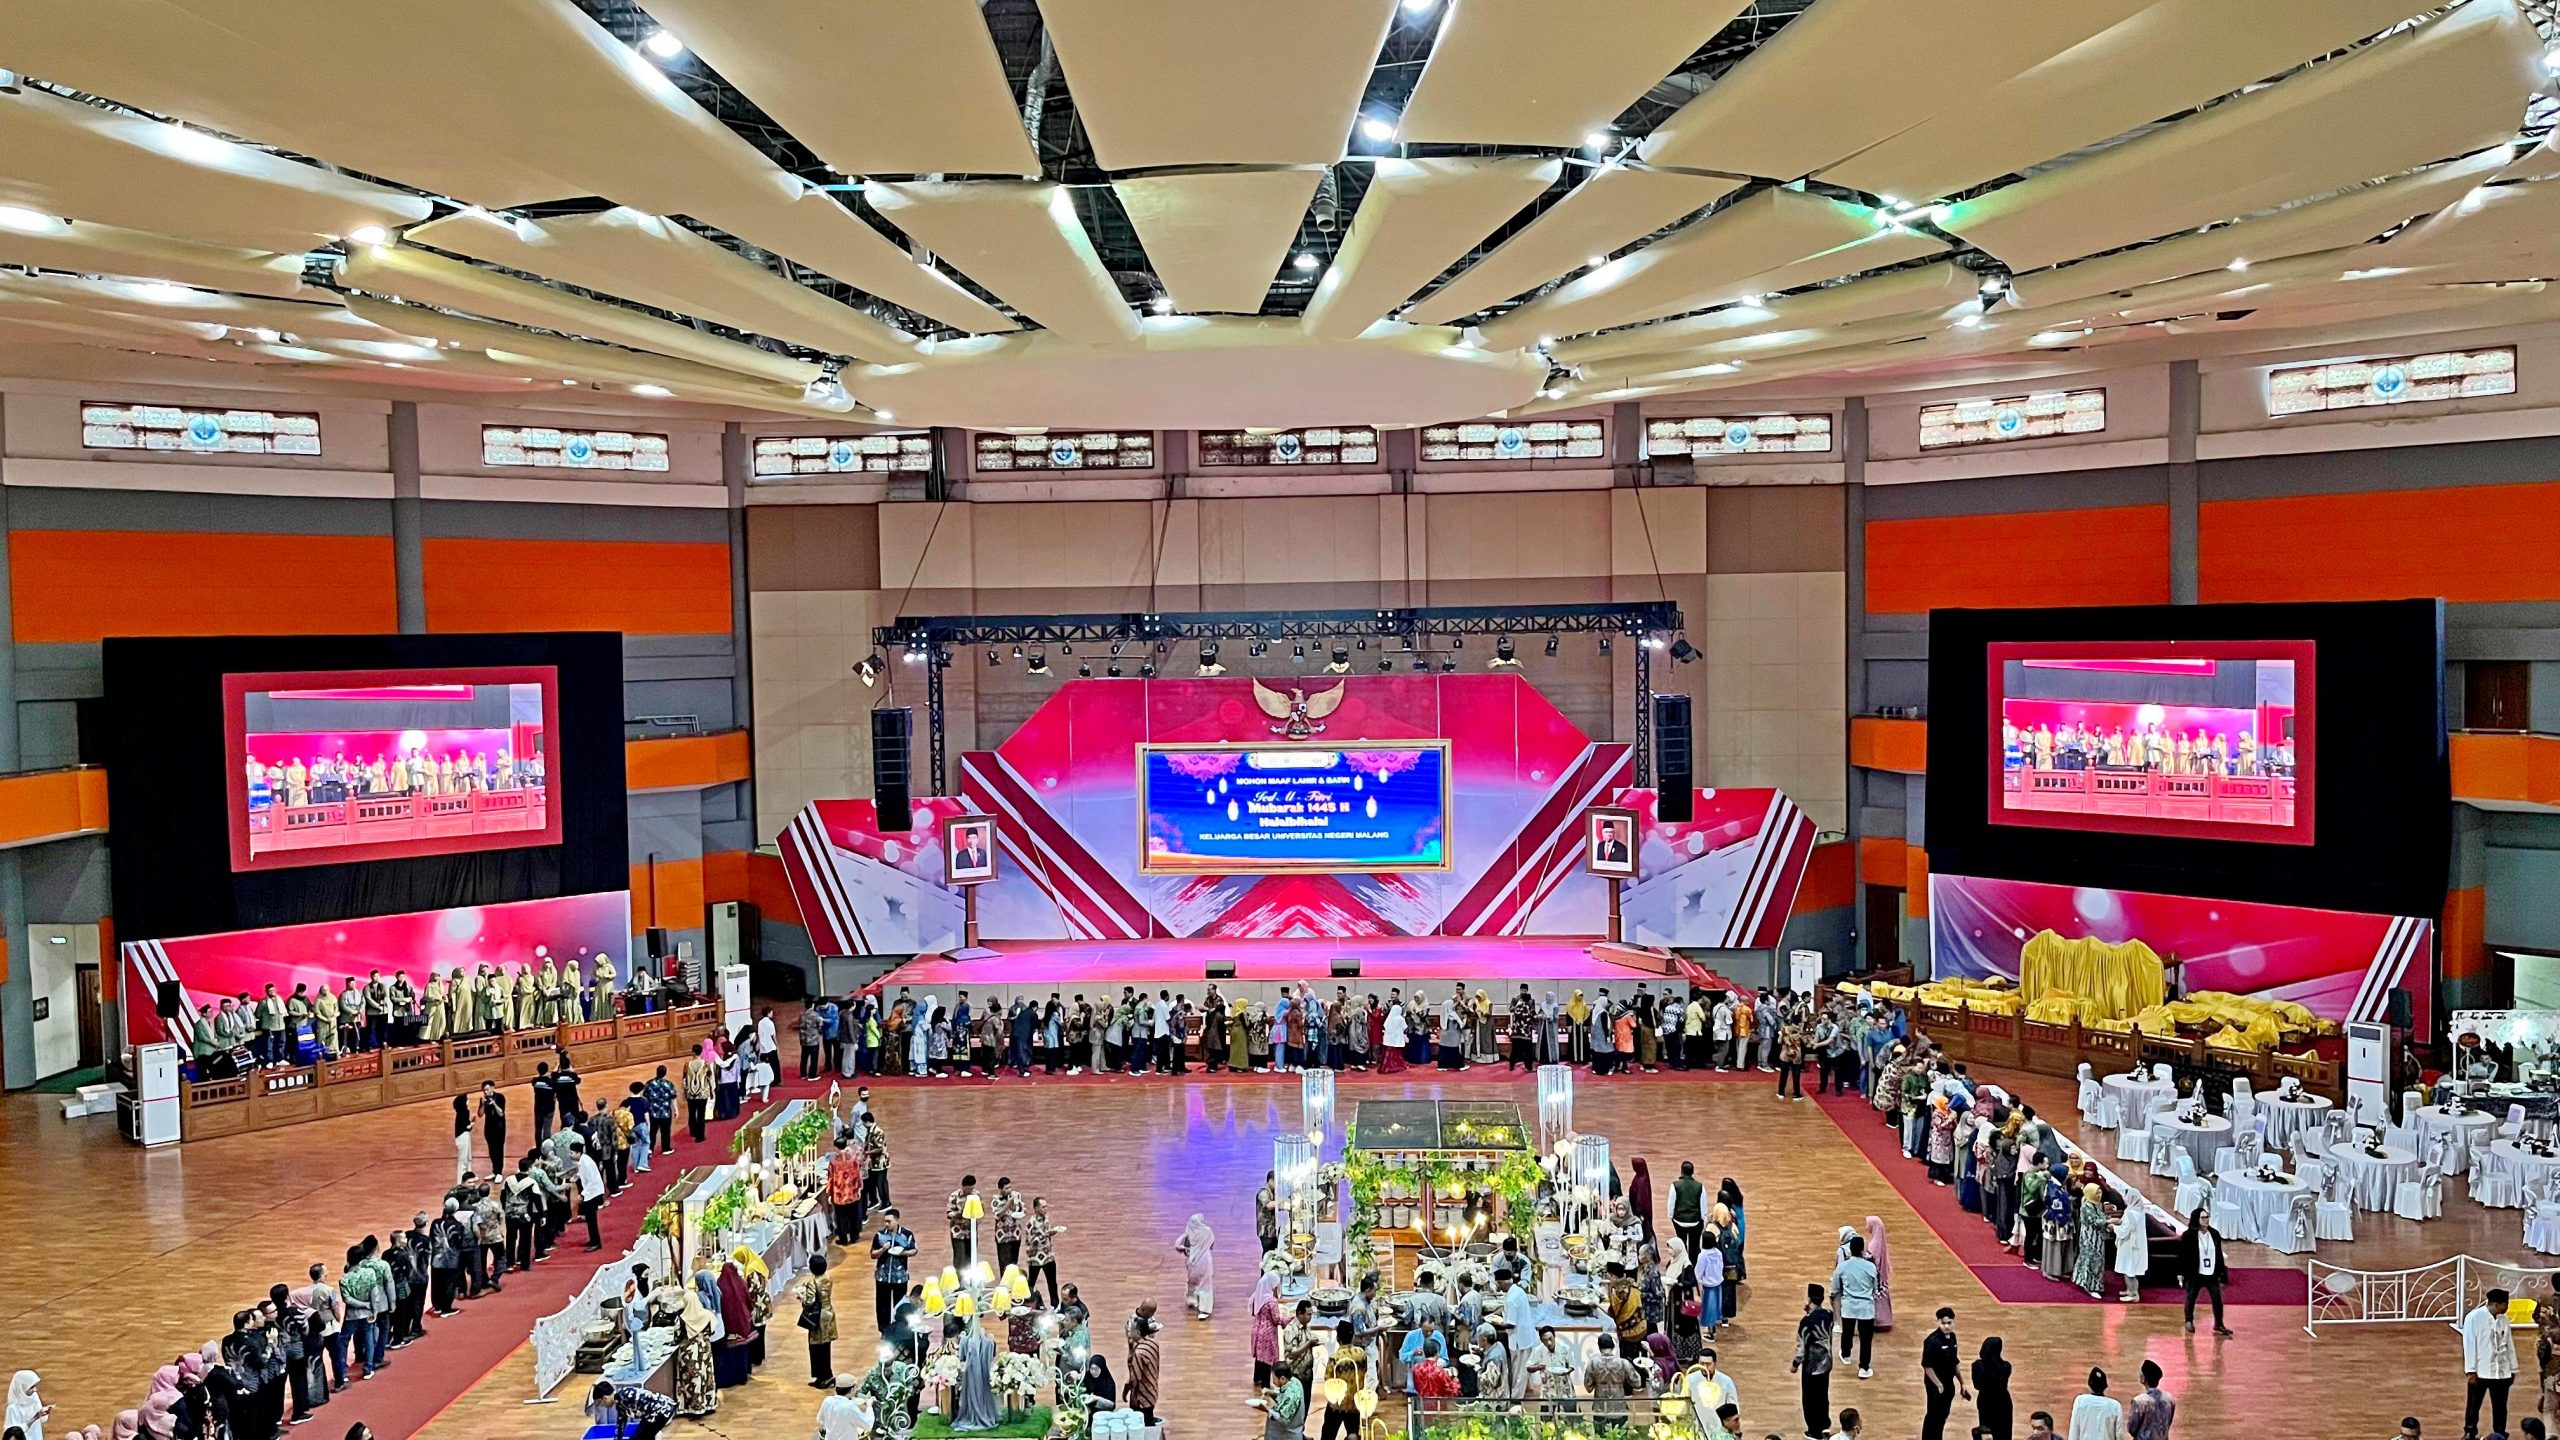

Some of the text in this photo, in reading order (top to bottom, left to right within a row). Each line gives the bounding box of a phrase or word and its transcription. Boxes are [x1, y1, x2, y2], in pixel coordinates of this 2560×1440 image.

[1236, 777, 1267, 785] MOHON
[1268, 777, 1291, 785] MAAF
[1304, 791, 1333, 802] Fitri
[1248, 801, 1350, 813] Mubarak 1445 H
